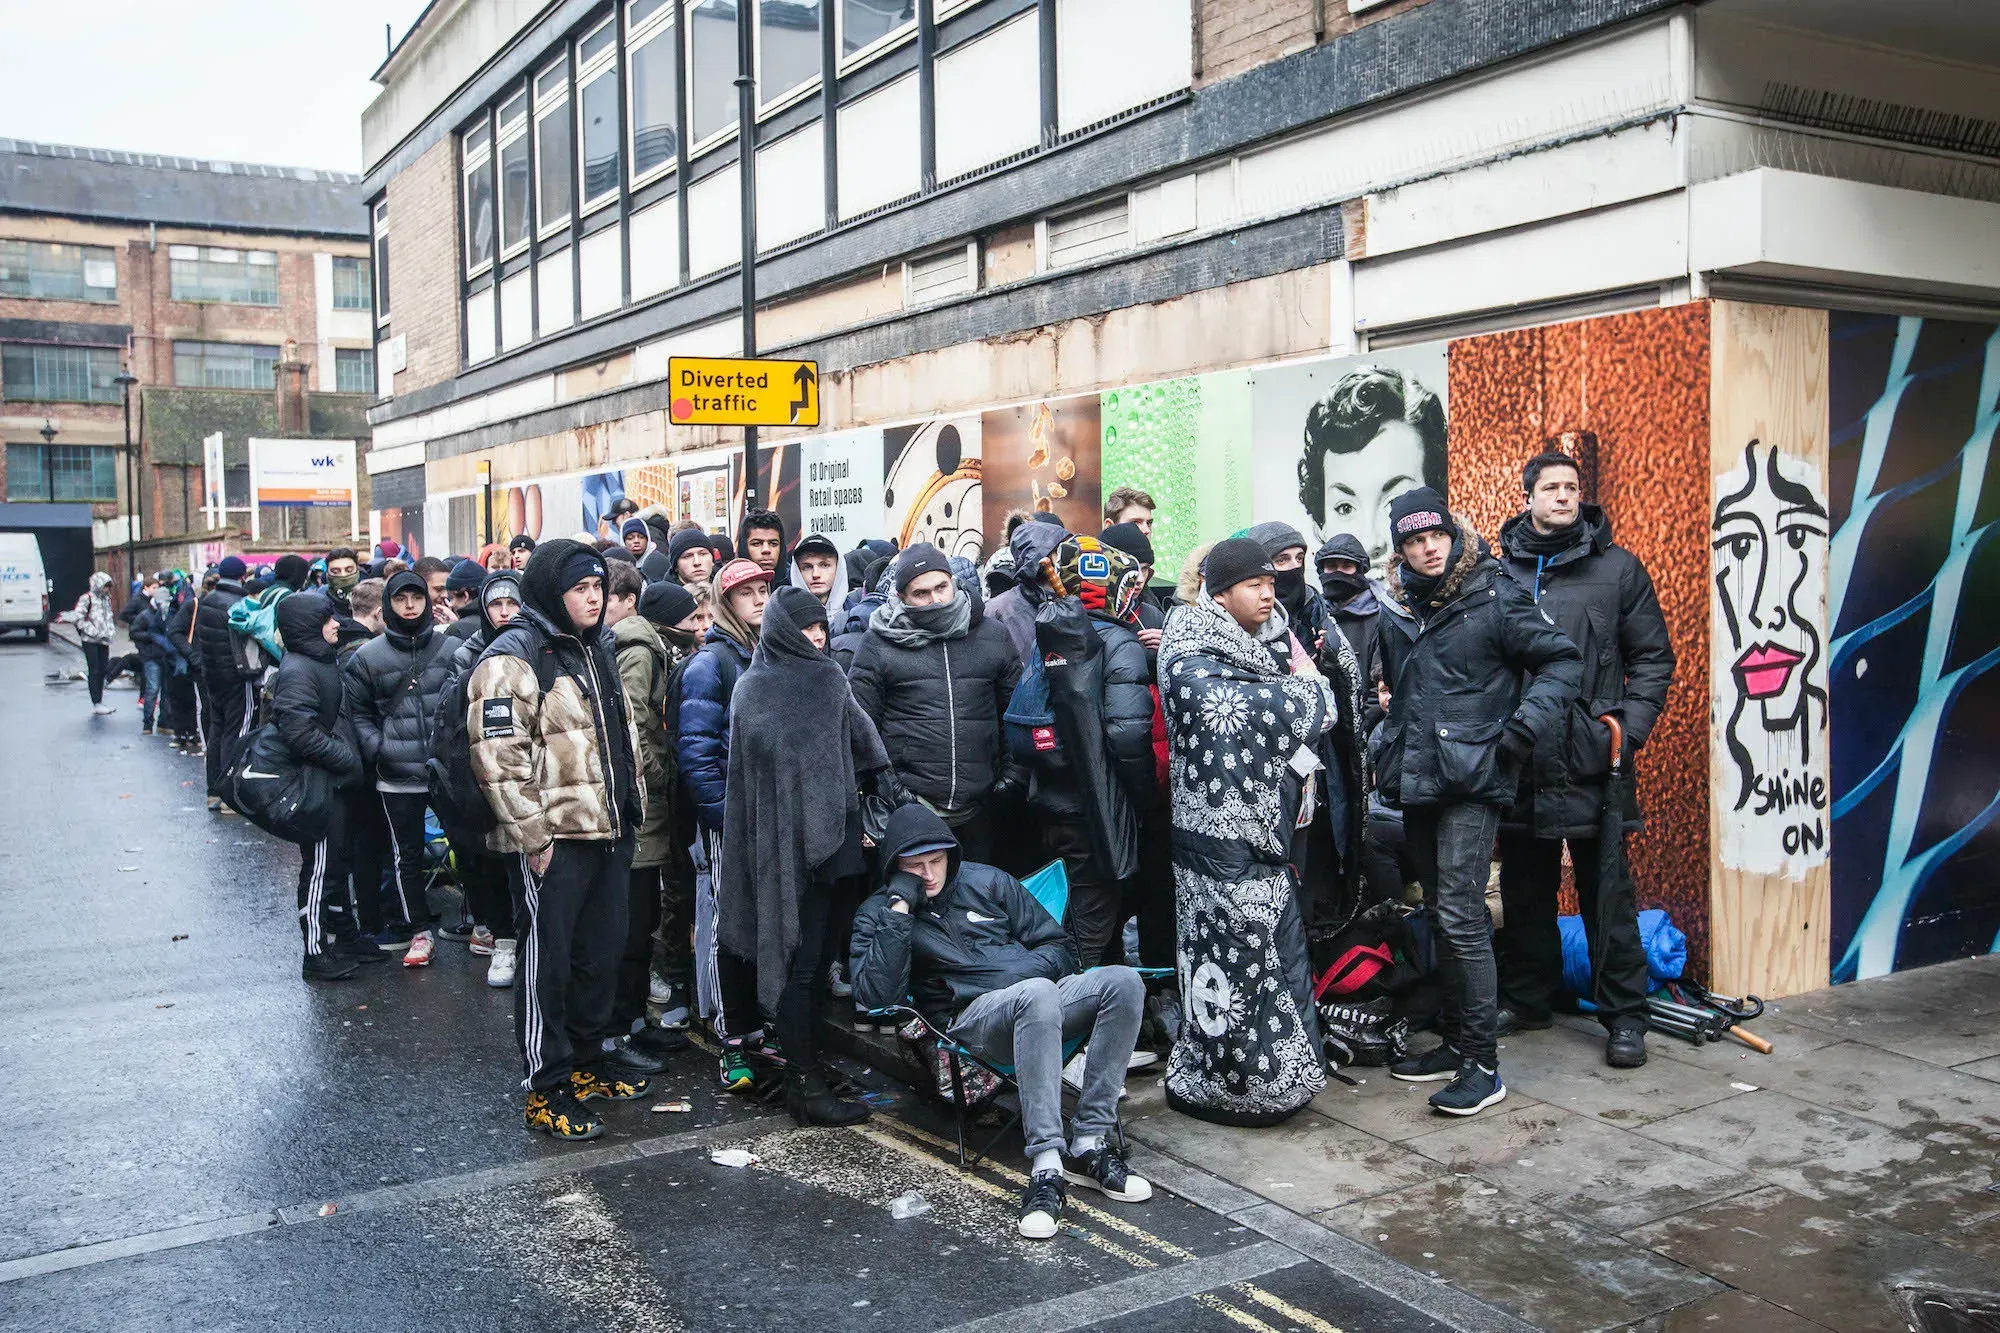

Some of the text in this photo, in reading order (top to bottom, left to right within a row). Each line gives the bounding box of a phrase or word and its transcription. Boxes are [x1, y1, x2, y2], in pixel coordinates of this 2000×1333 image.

[681, 369, 768, 388] Diverted
[693, 394, 757, 411] traffic
[311, 456, 335, 467] wk
[809, 458, 849, 483] 13 Original
[809, 487, 863, 508] Retail spaces
[810, 513, 847, 533] available.
[1397, 511, 1443, 534] SUPREME
[1782, 818, 1824, 855] ON
